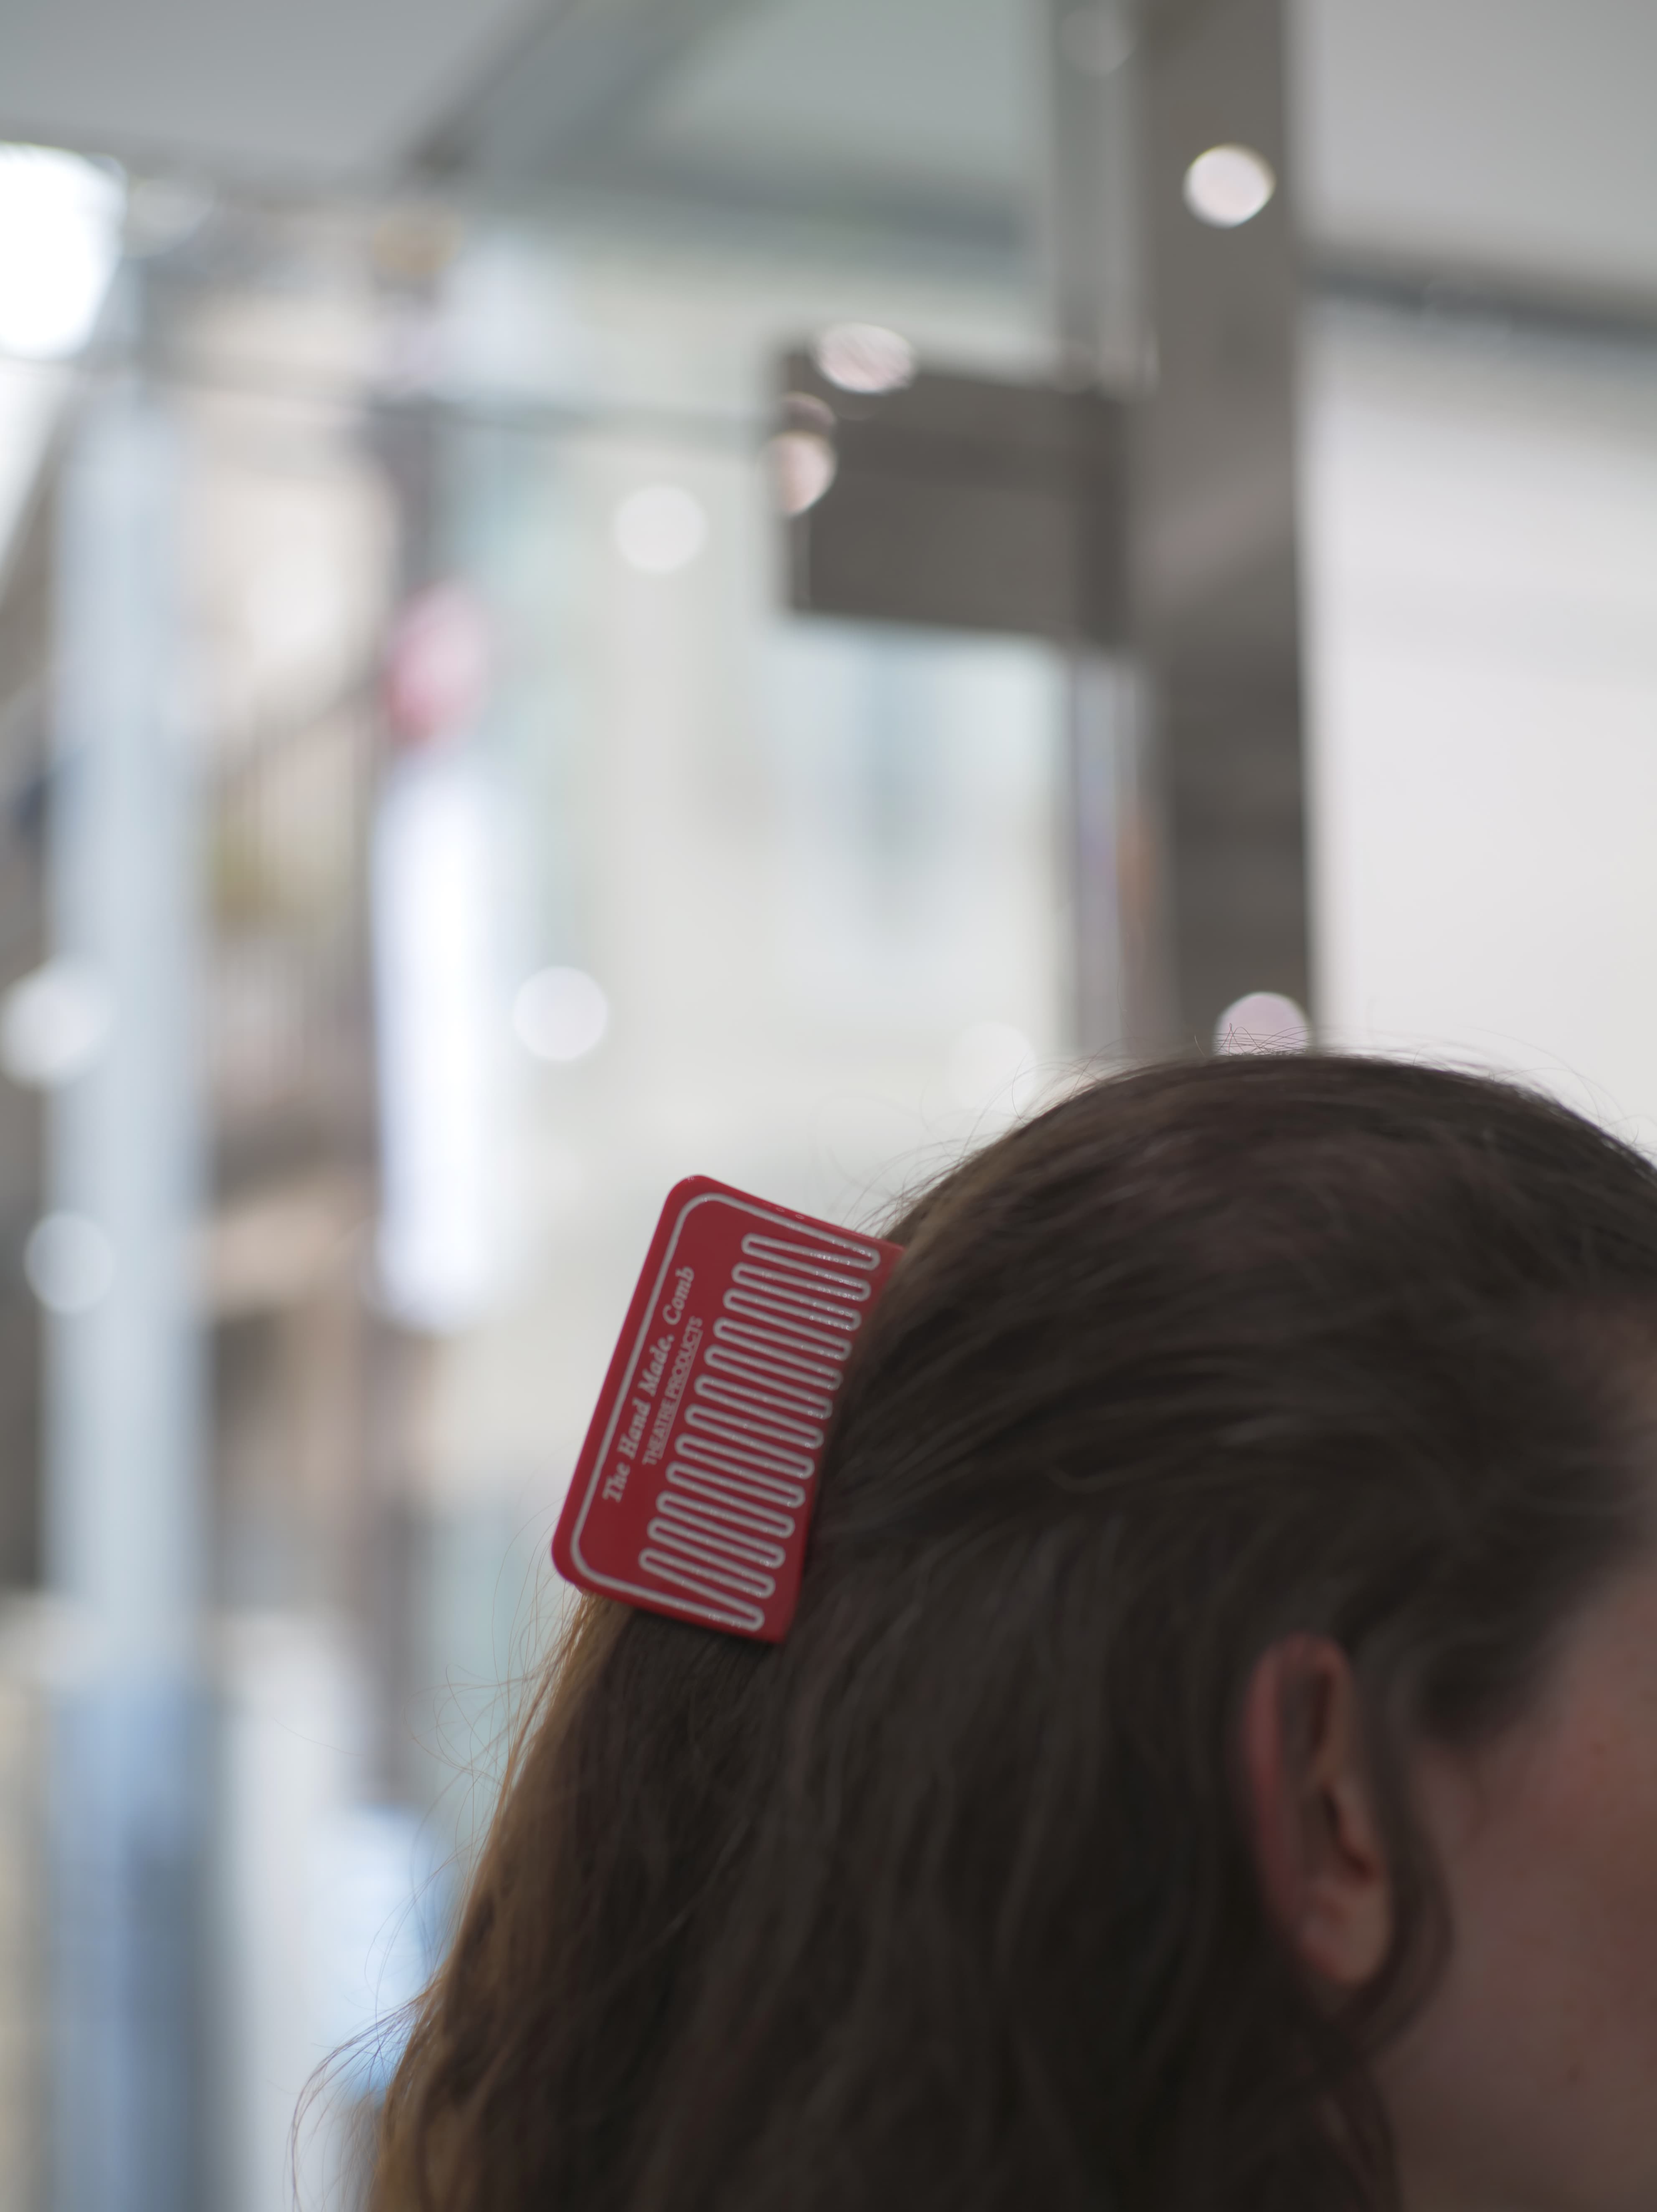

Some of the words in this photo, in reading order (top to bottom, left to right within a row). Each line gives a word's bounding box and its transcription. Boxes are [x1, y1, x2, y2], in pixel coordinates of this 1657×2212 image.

[602, 1462, 630, 1503] The
[617, 1397, 651, 1459] Hand
[637, 1334, 675, 1397] Made.
[662, 1266, 694, 1325] Comb
[642, 1398, 676, 1465] THEATRE
[664, 1315, 703, 1400] PRODUCTS
